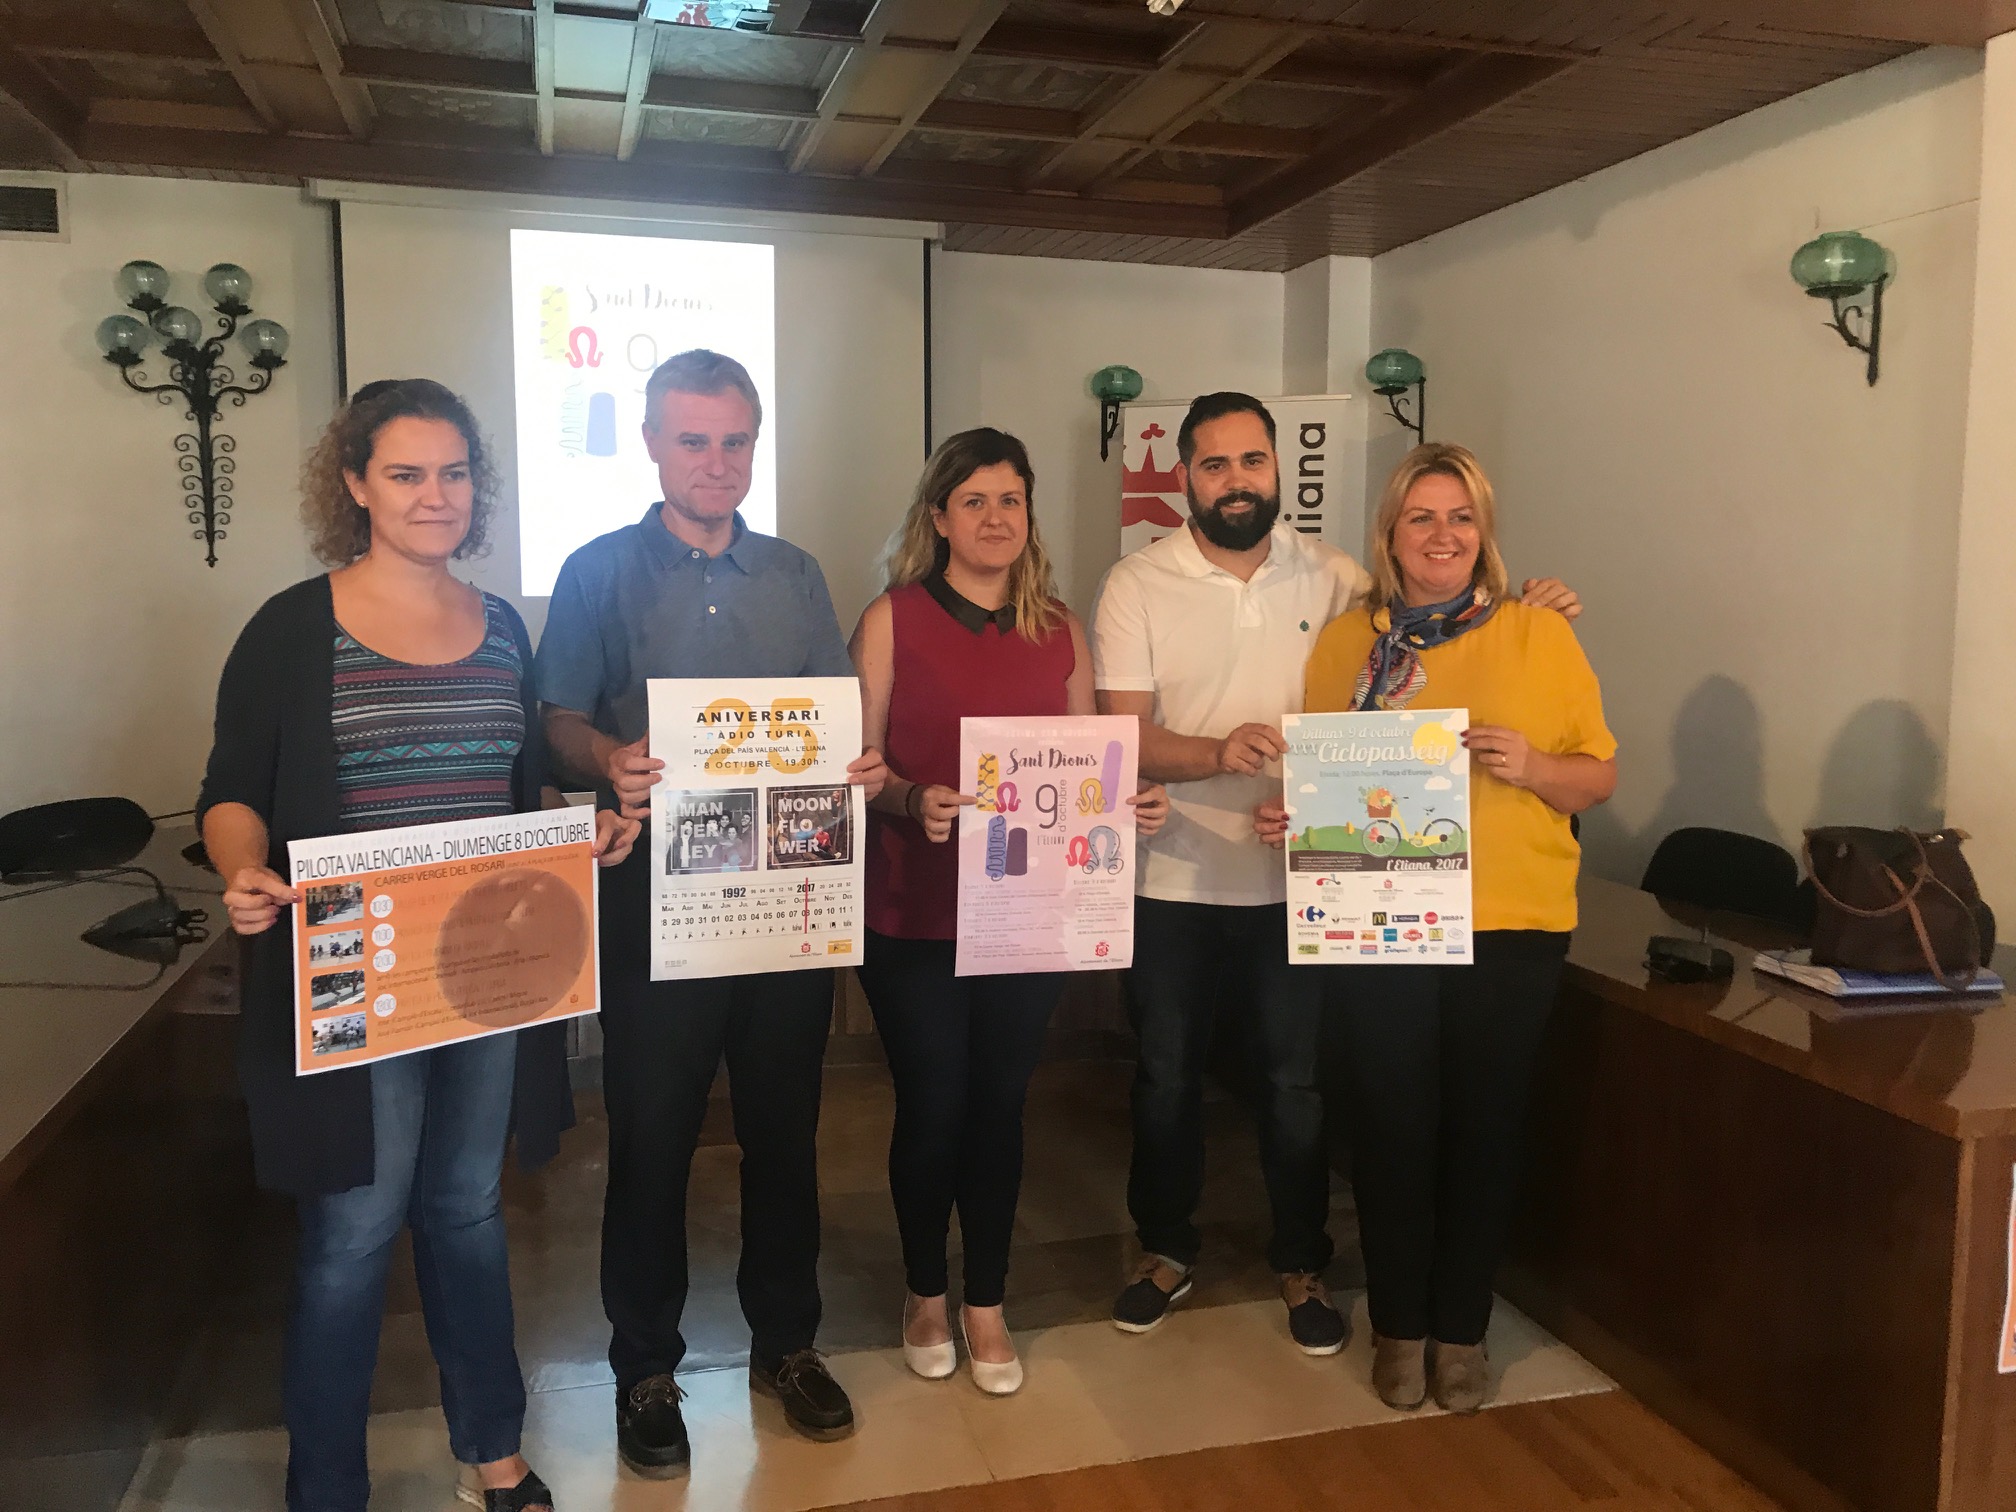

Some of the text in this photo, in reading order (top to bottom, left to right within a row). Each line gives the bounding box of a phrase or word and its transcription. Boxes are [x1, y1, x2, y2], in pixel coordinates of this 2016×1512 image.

[1284, 422, 1326, 541] liana
[696, 709, 820, 723] ANIVERSARI
[704, 697, 819, 776] 25
[765, 728, 812, 740] TÚRIA
[1302, 727, 1344, 741] Dilluns
[694, 747, 719, 757] PLAÇA
[721, 747, 735, 755] DEL
[737, 745, 754, 754] PAÍS
[756, 745, 790, 754] VALENCIÀ
[796, 744, 827, 753] L'ELIANA
[1318, 739, 1449, 768] Ciclopasseig
[716, 760, 771, 770] OCTUBRE
[785, 757, 819, 768] 19.30h
[1007, 747, 1098, 776] Sant Dionís
[680, 801, 724, 818] MAN
[778, 796, 832, 813] MOON
[1035, 783, 1059, 830] 9
[1057, 778, 1067, 833] d'octubre
[779, 817, 814, 834] FLO
[297, 854, 346, 879] PILOTA
[346, 842, 434, 873] VALENCIANA
[444, 831, 513, 860] DIUMENGE
[515, 832, 522, 851] 8
[524, 822, 591, 849] D'OCTUBRE
[780, 838, 819, 855] WER
[374, 870, 415, 888] CARRER
[416, 867, 448, 882] VERGE
[450, 865, 468, 878] DEL
[471, 859, 505, 875] ROSARI
[1435, 858, 1465, 872] 2017
[721, 887, 747, 899] 1992
[796, 883, 816, 895] 2017
[661, 918, 668, 927] 8
[671, 918, 681, 926] 29
[684, 917, 695, 925] 30
[697, 916, 707, 924] 31
[711, 915, 721, 923] 01
[724, 914, 734, 922] 02
[737, 913, 747, 921] 03
[750, 912, 760, 921] 04
[763, 912, 773, 920] 05
[776, 911, 786, 919] 06
[788, 910, 798, 918] 07
[813, 908, 823, 916] 09
[826, 907, 835, 915] 10
[838, 906, 846, 914] 11
